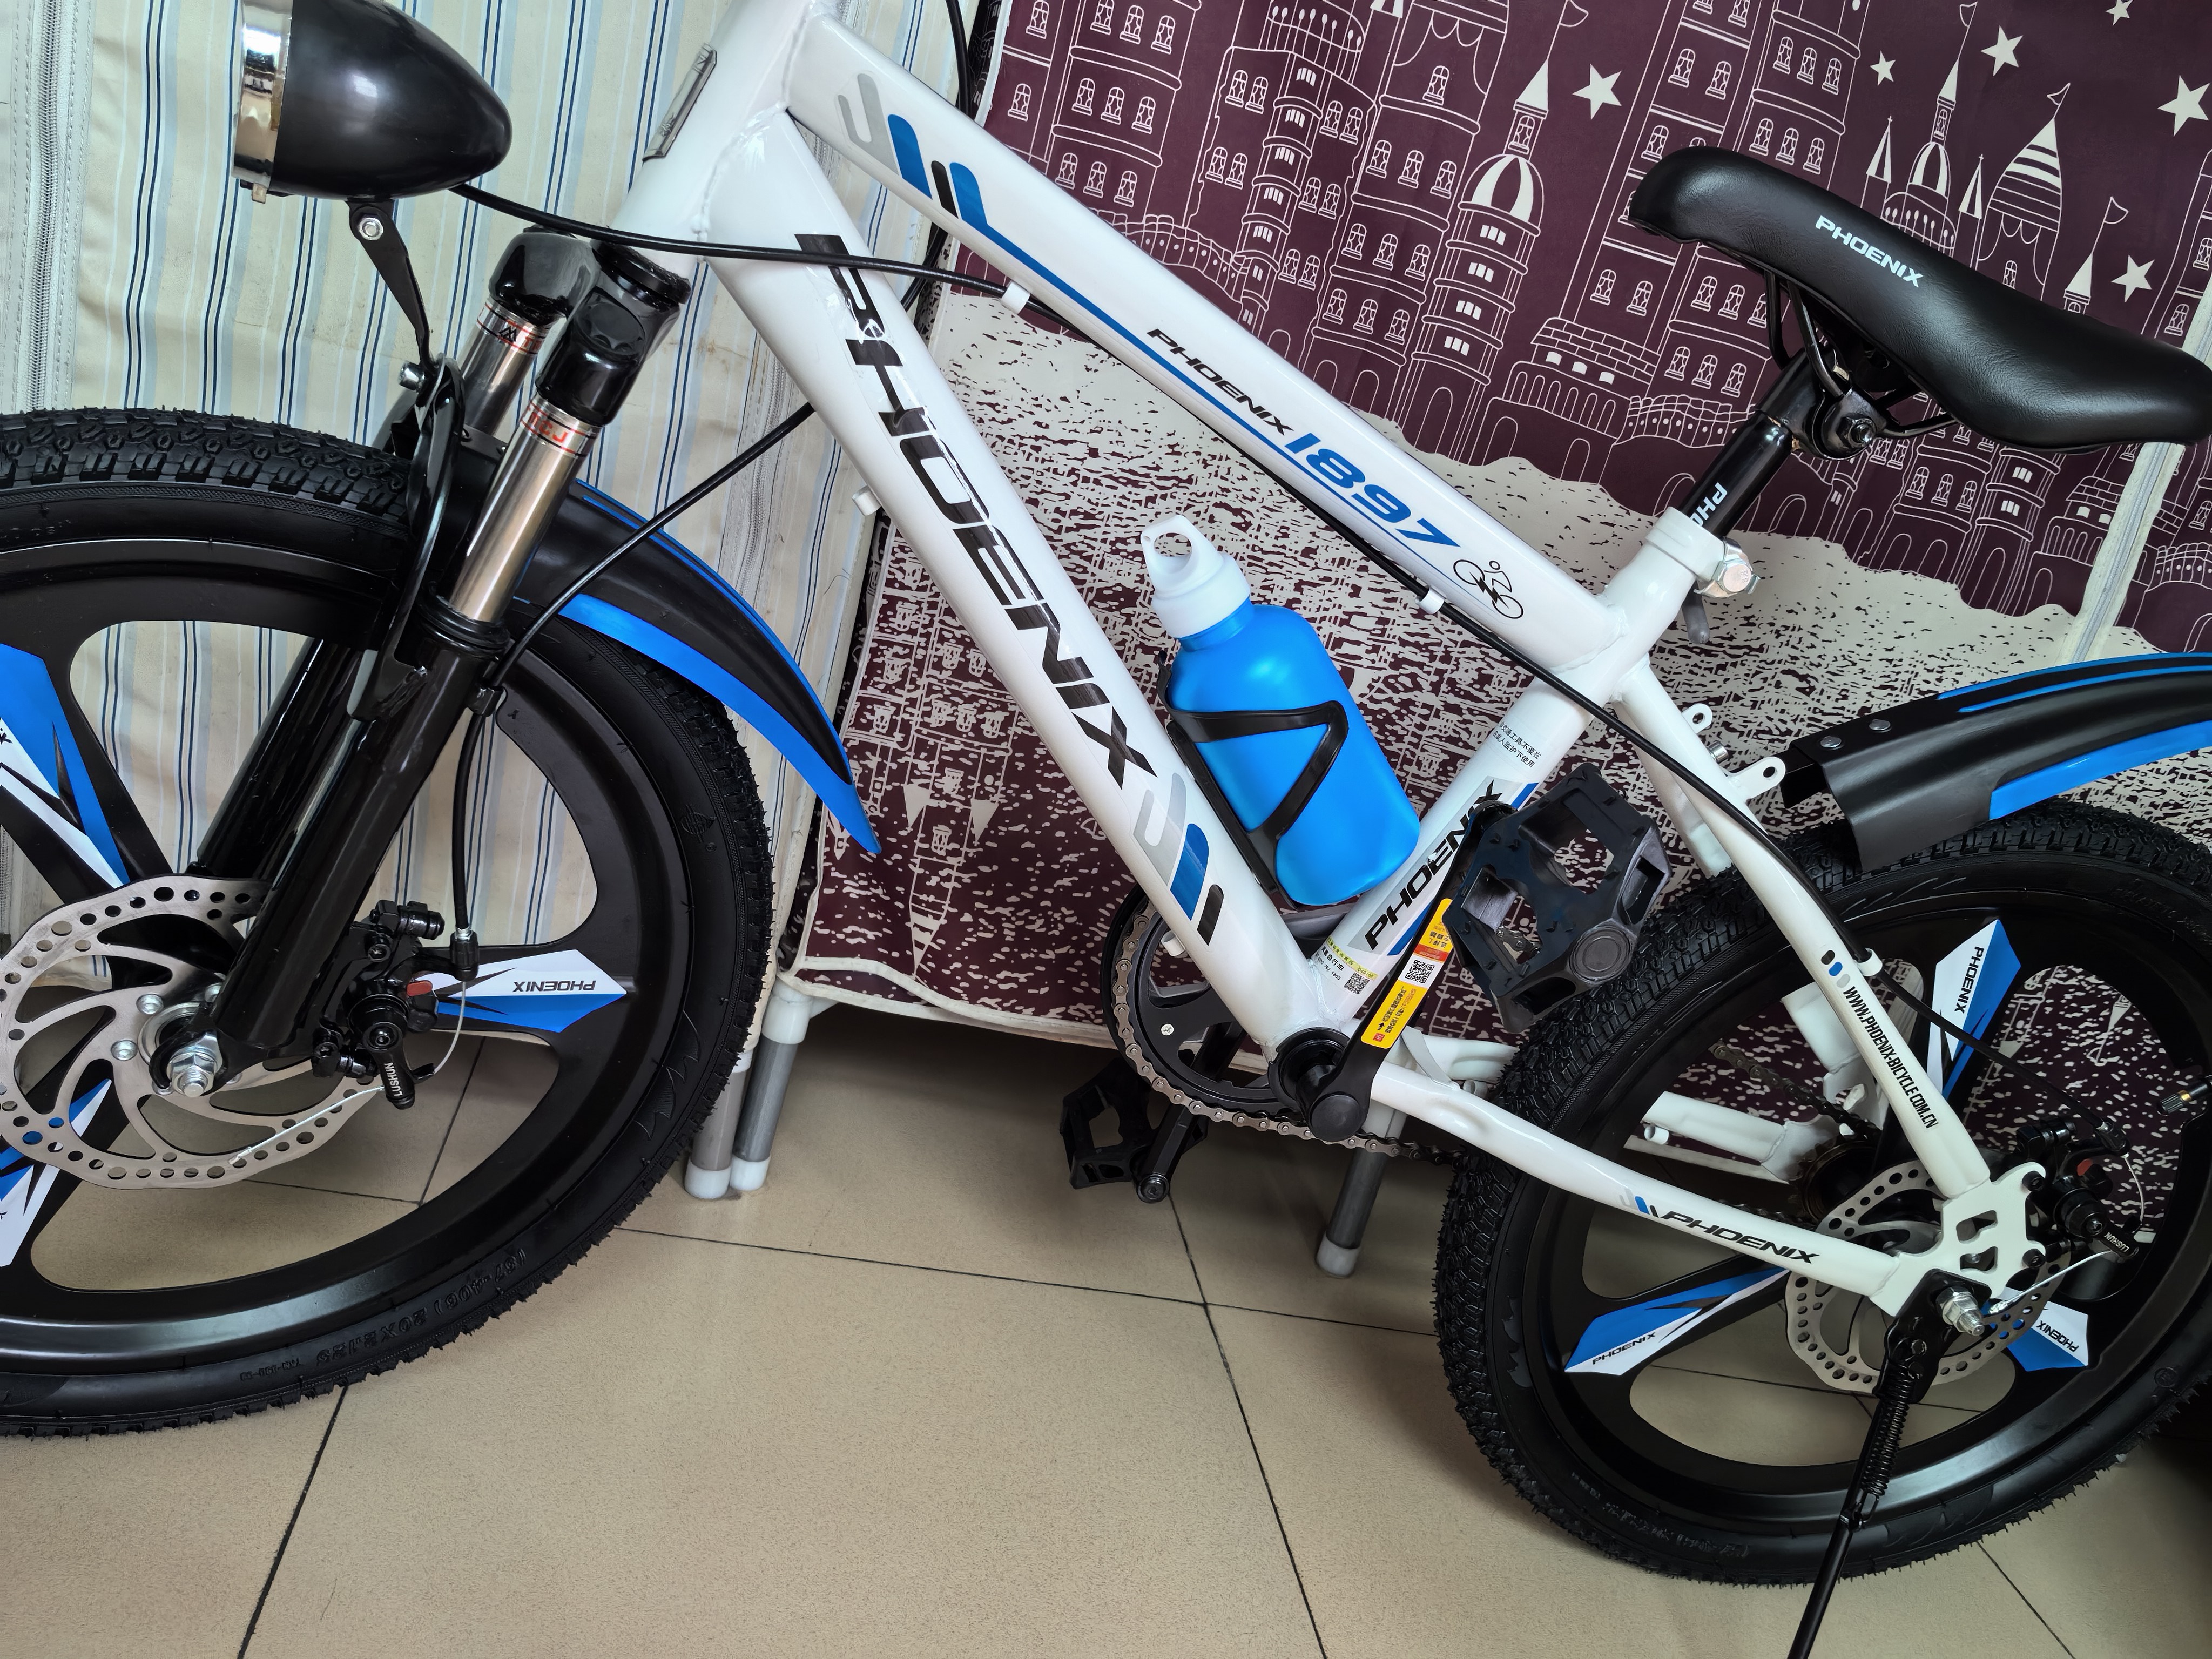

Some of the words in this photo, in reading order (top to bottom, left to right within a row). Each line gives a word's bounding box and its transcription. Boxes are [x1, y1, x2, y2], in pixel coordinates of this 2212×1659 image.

[1816, 215, 1924, 288] PHOENIX
[1143, 328, 1294, 435] PHOENIX
[1284, 433, 1461, 548] 1897
[793, 233, 1157, 791] PHOENIX
[1364, 779, 1502, 950] PHOENX
[512, 980, 596, 992] PHOENIX
[1954, 946, 1984, 1014] PHOENIX
[385, 1062, 403, 1097] LUSHUN
[1660, 1210, 1819, 1264] PHOENIX
[2103, 1231, 2130, 1252] LUSHUN
[1592, 1332, 1656, 1365] PHOENIX
[2035, 1319, 2079, 1353] PHOENIX
